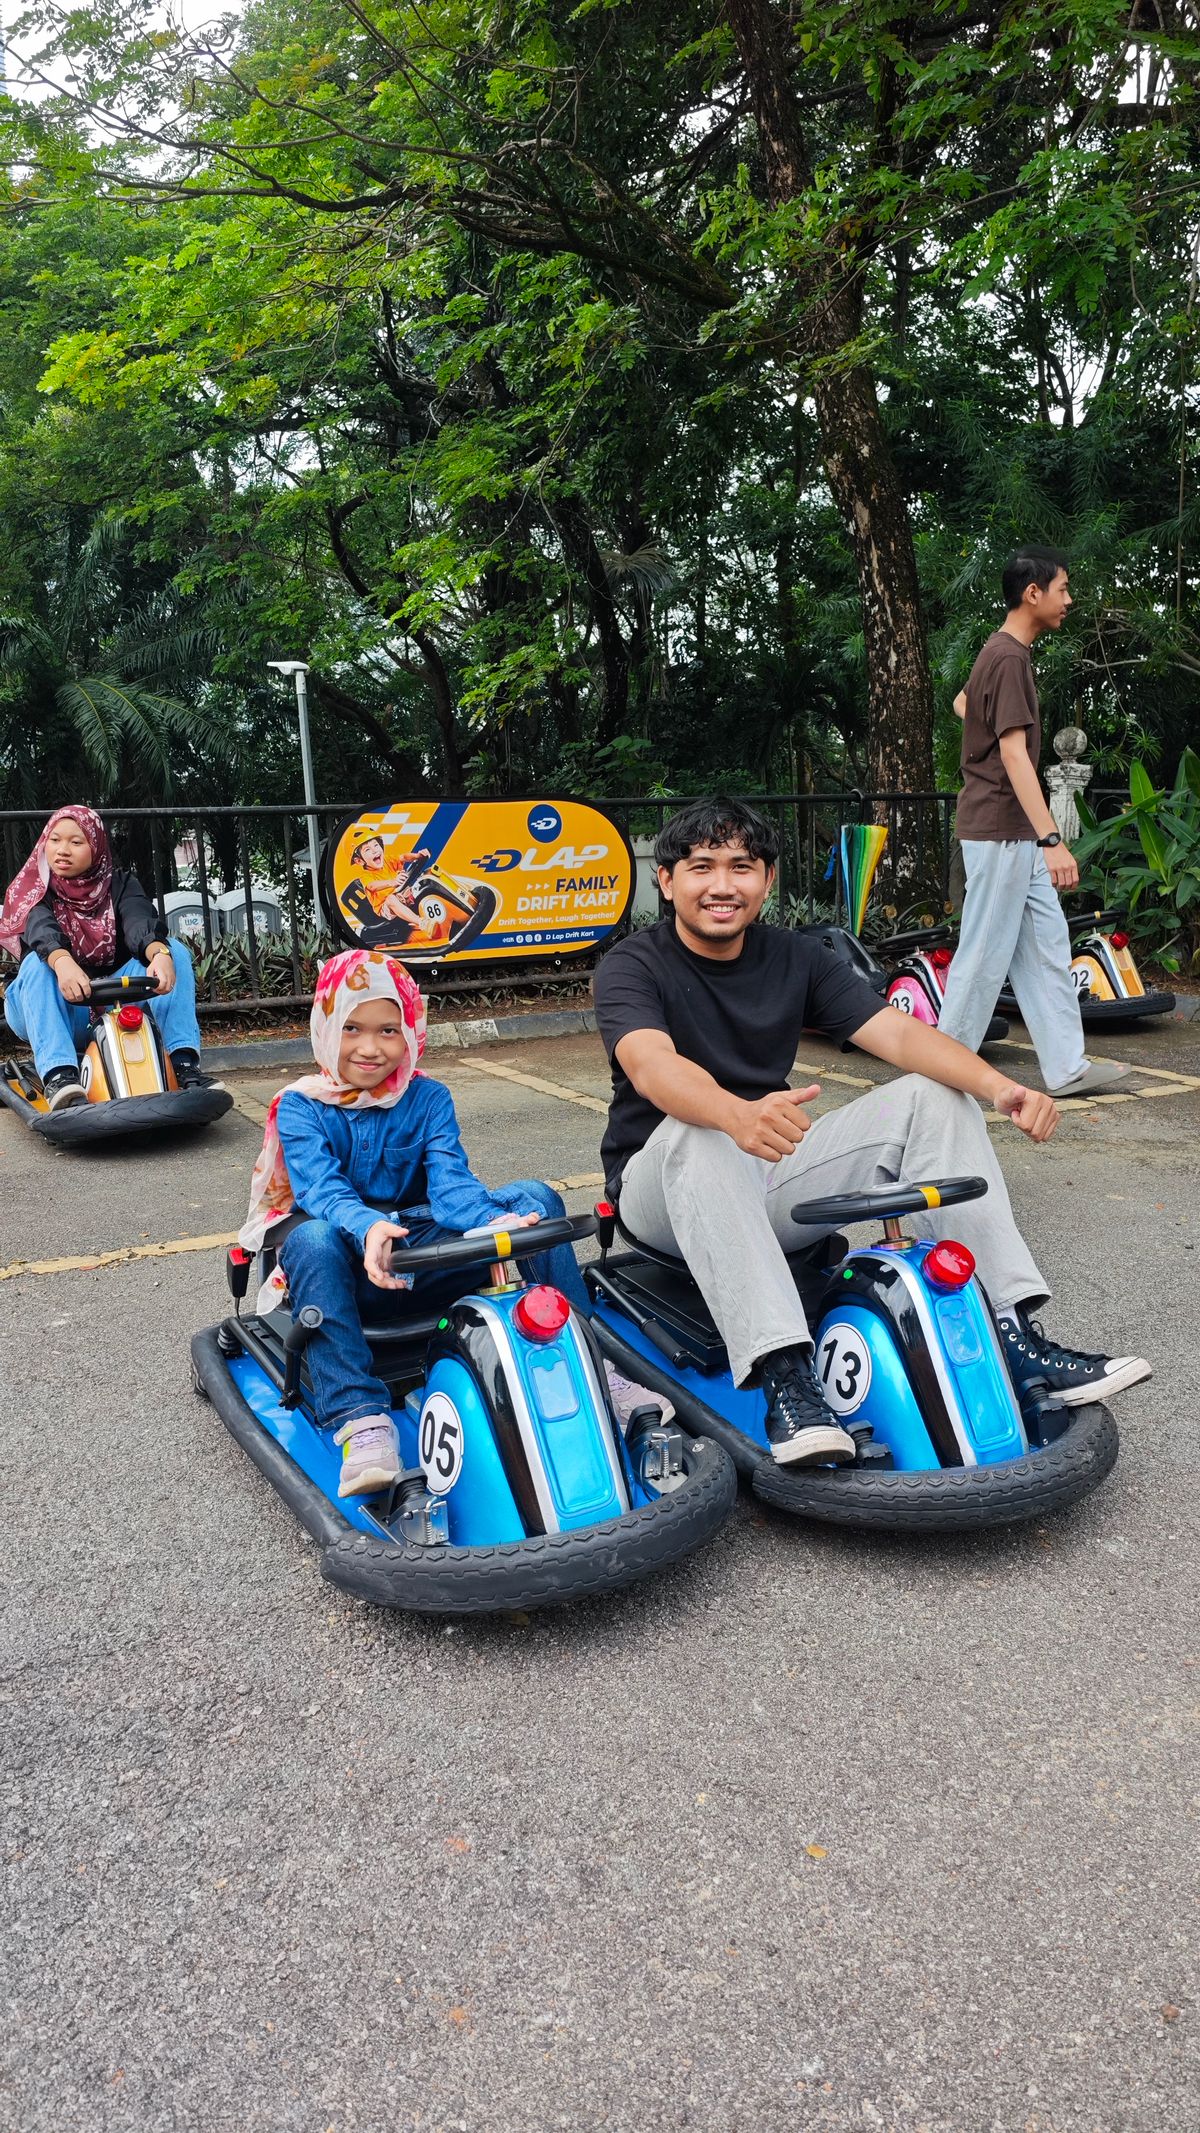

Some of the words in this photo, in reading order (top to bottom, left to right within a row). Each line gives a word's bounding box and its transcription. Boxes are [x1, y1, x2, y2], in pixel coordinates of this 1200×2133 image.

[470, 844, 609, 873] DLAP
[555, 875, 619, 892] FAMILY
[426, 903, 442, 919] 86
[516, 894, 570, 912] DRIFT
[573, 891, 620, 908] KART
[498, 918, 516, 926] Drift
[518, 915, 554, 926] Together,
[555, 914, 579, 924] Laugh
[581, 911, 615, 922] Together!
[552, 934, 565, 942] Lap
[565, 932, 580, 940] Drift
[581, 930, 595, 938] Kart
[822, 1339, 861, 1400] 13
[422, 1411, 458, 1477] 05
